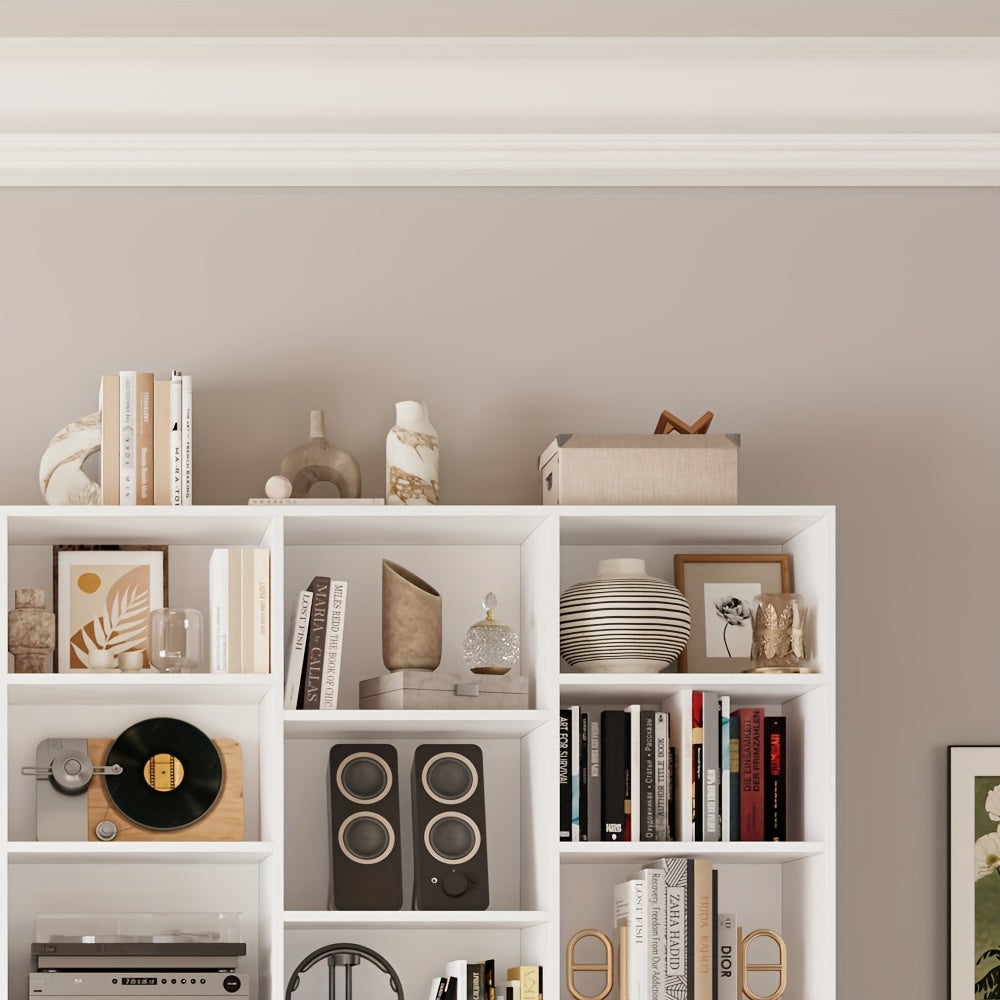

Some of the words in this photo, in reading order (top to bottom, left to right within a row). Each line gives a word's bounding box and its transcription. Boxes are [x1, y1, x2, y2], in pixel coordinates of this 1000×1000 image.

[299, 593, 311, 621] LOST
[312, 584, 328, 632] MARIA
[333, 584, 344, 609] MILES
[331, 610, 342, 633] REDD
[295, 622, 307, 651] FISH
[306, 647, 323, 703] CALLAS
[743, 779, 751, 792] DIE
[635, 883, 643, 912] LOST
[669, 893, 680, 928] ZAHA
[635, 917, 643, 944] FISH
[651, 907, 661, 938] Freedom
[651, 939, 661, 955] From
[669, 930, 680, 970] HADID
[720, 945, 732, 978] DIOR
[651, 956, 661, 969] Our
